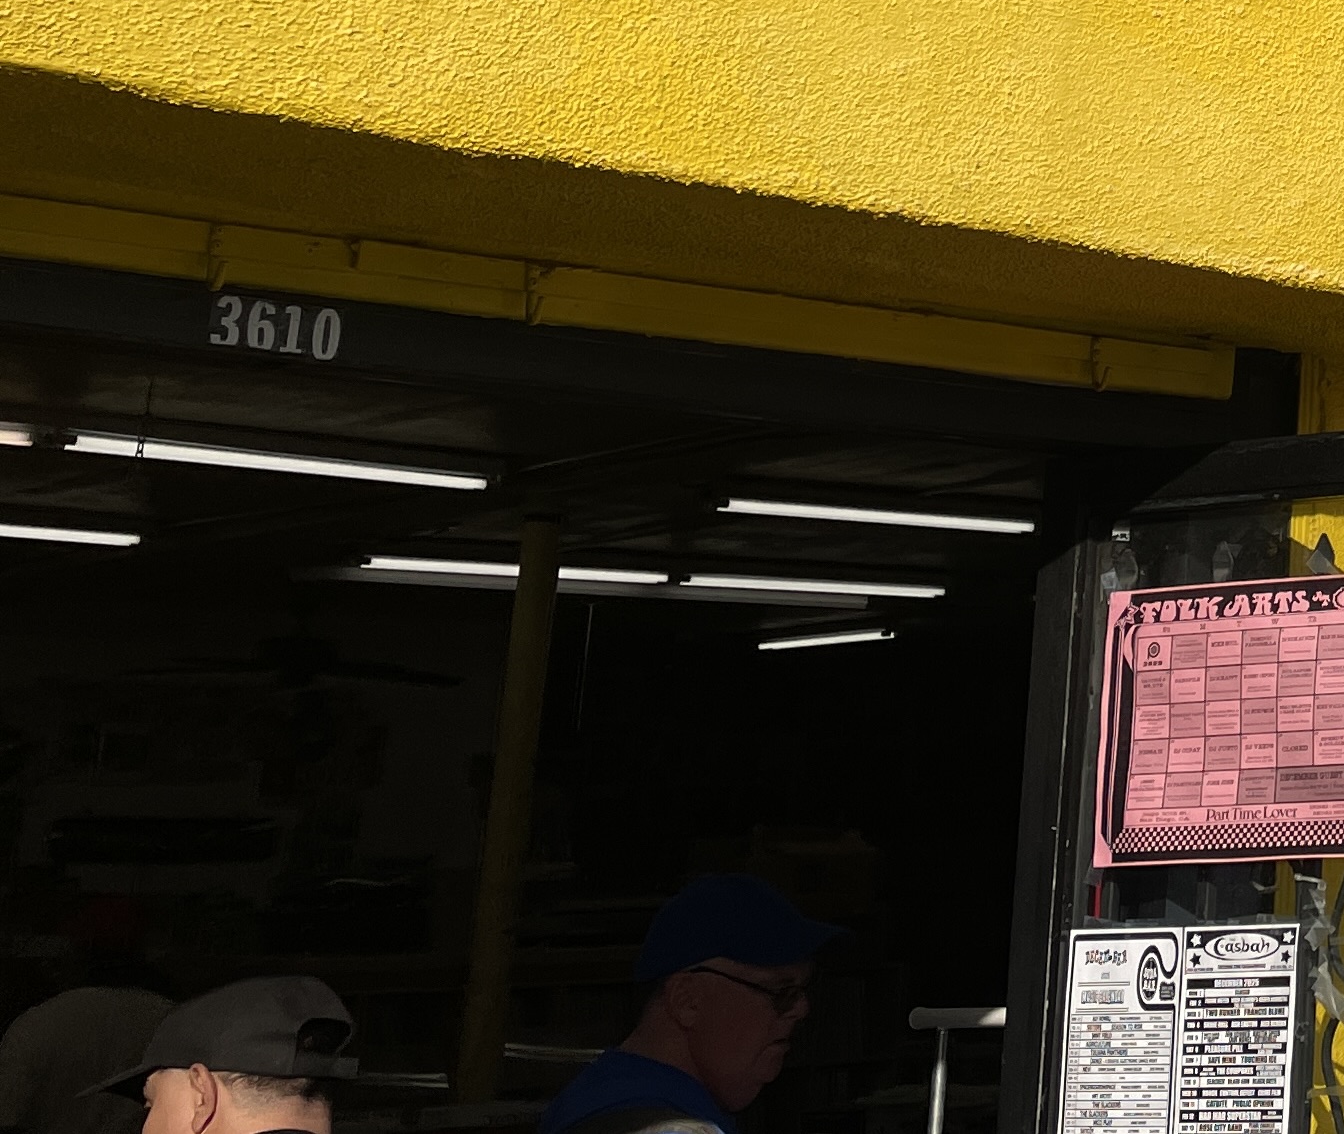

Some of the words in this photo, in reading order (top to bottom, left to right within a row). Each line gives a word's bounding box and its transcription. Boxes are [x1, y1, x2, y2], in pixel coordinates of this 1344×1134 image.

[209, 295, 342, 361] 3610
[1140, 596, 1224, 624] FOLK
[1223, 589, 1311, 619] ARTS
[1206, 808, 1230, 822] Part
[1229, 807, 1262, 821] Time
[1263, 806, 1298, 819] Lover
[1213, 936, 1270, 957] Casbah
